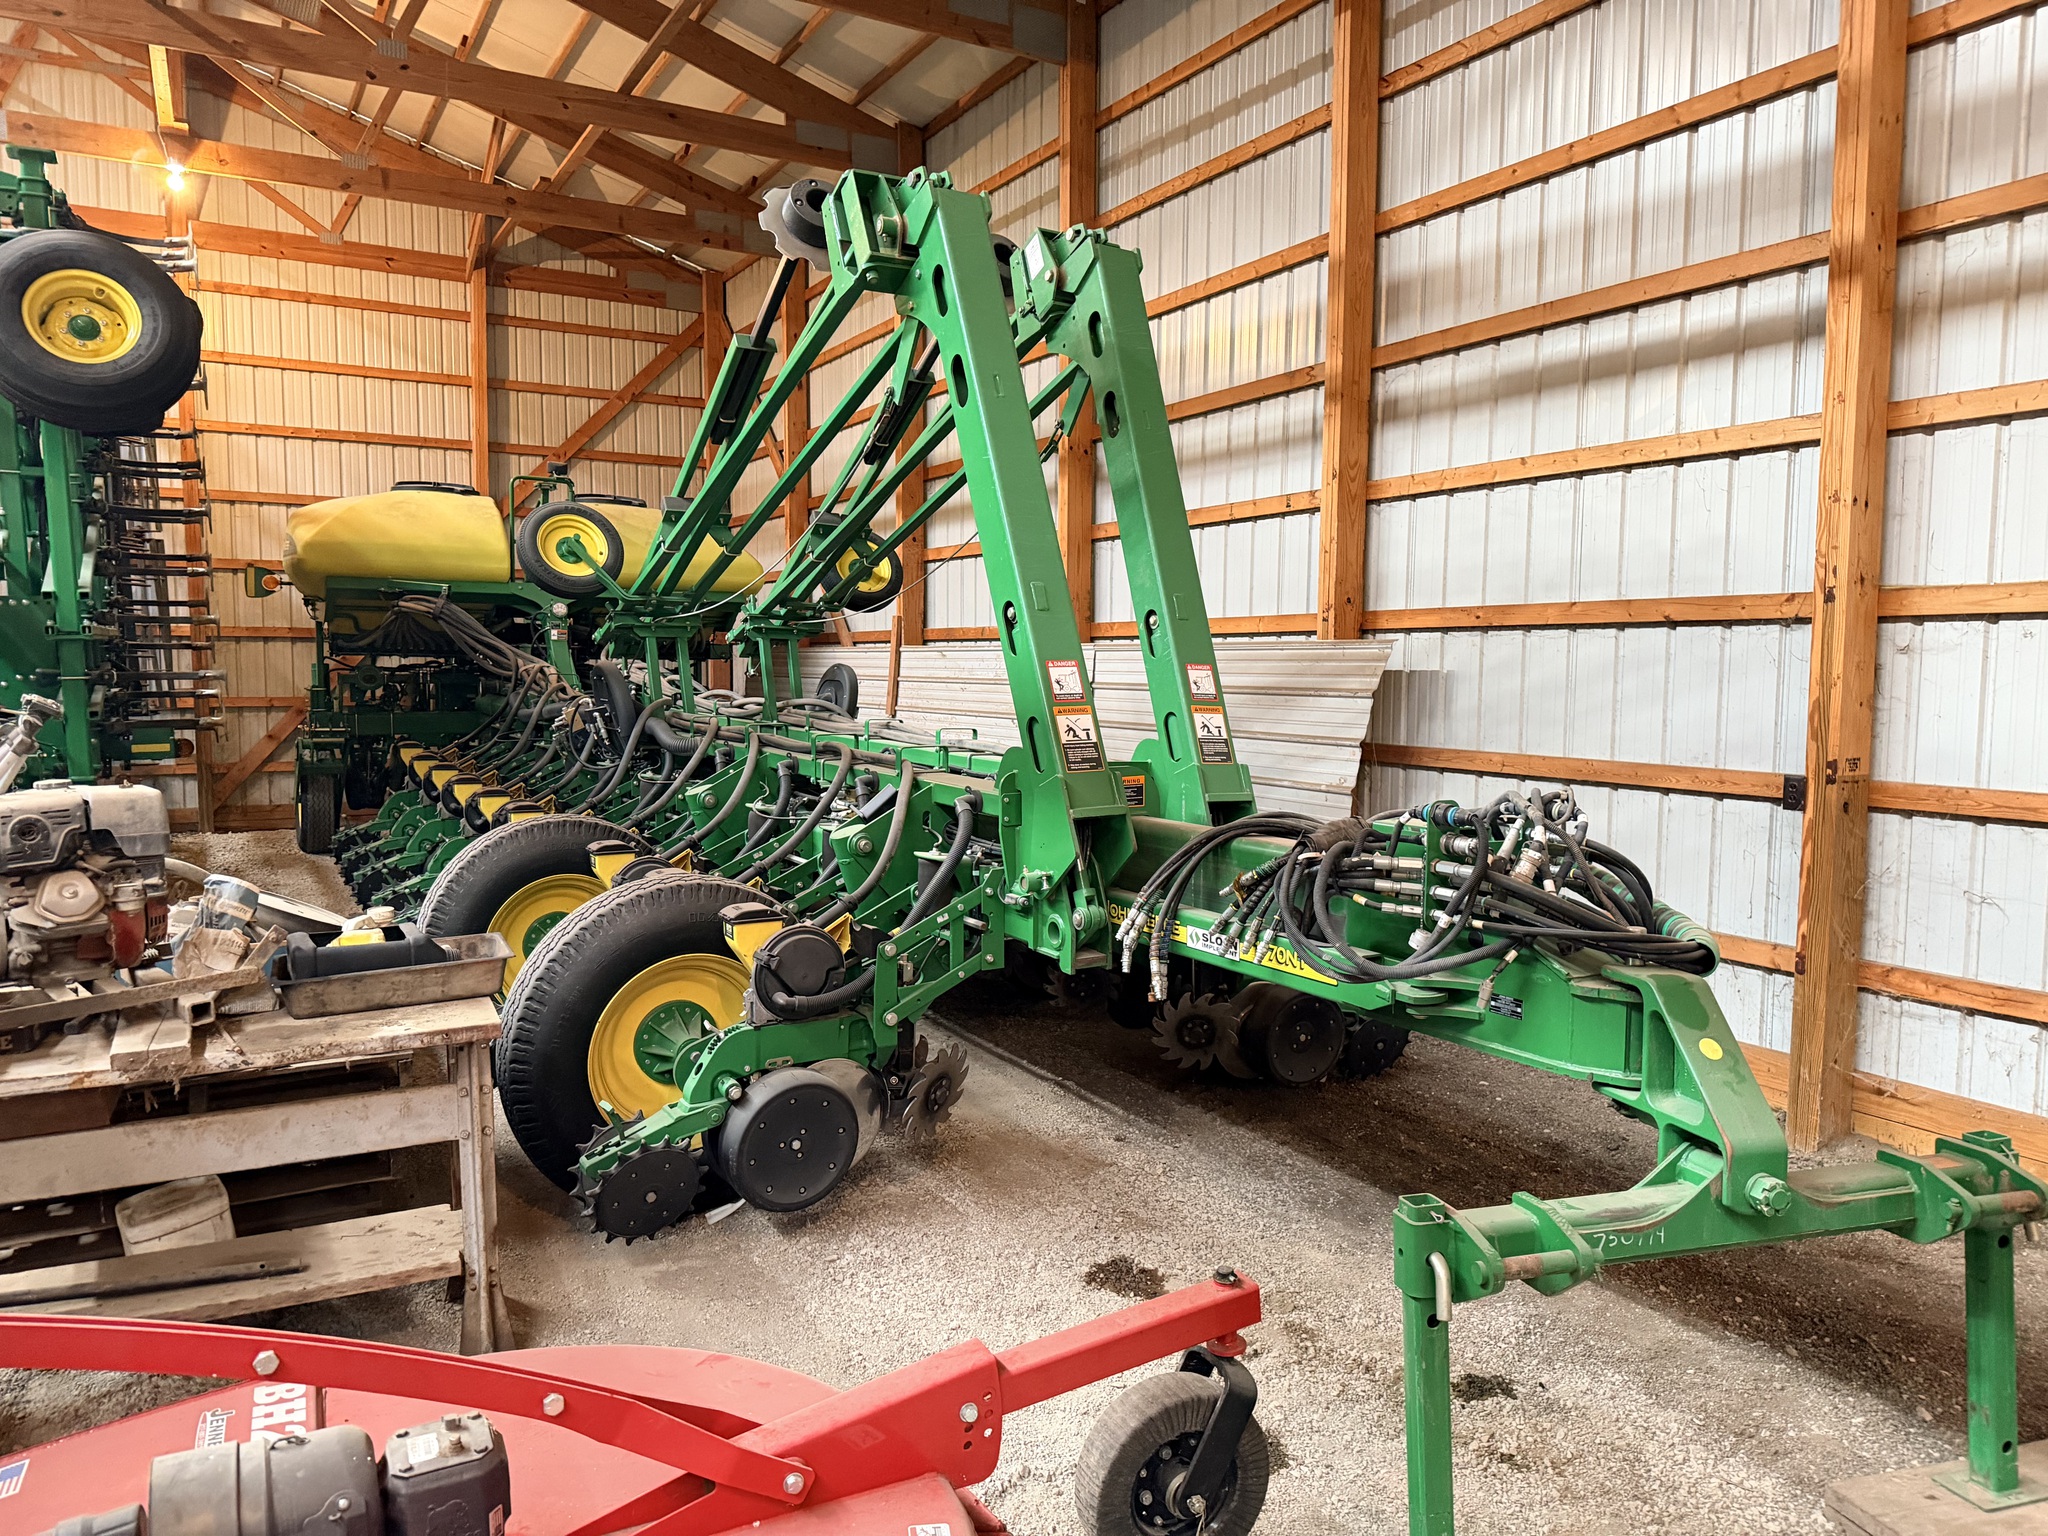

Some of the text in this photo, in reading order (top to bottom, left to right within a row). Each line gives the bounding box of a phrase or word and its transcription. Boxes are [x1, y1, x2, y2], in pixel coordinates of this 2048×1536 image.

[1108, 900, 1130, 921] JOH
[1202, 933, 1238, 951] SLON
[1202, 942, 1238, 957] IMPLENT
